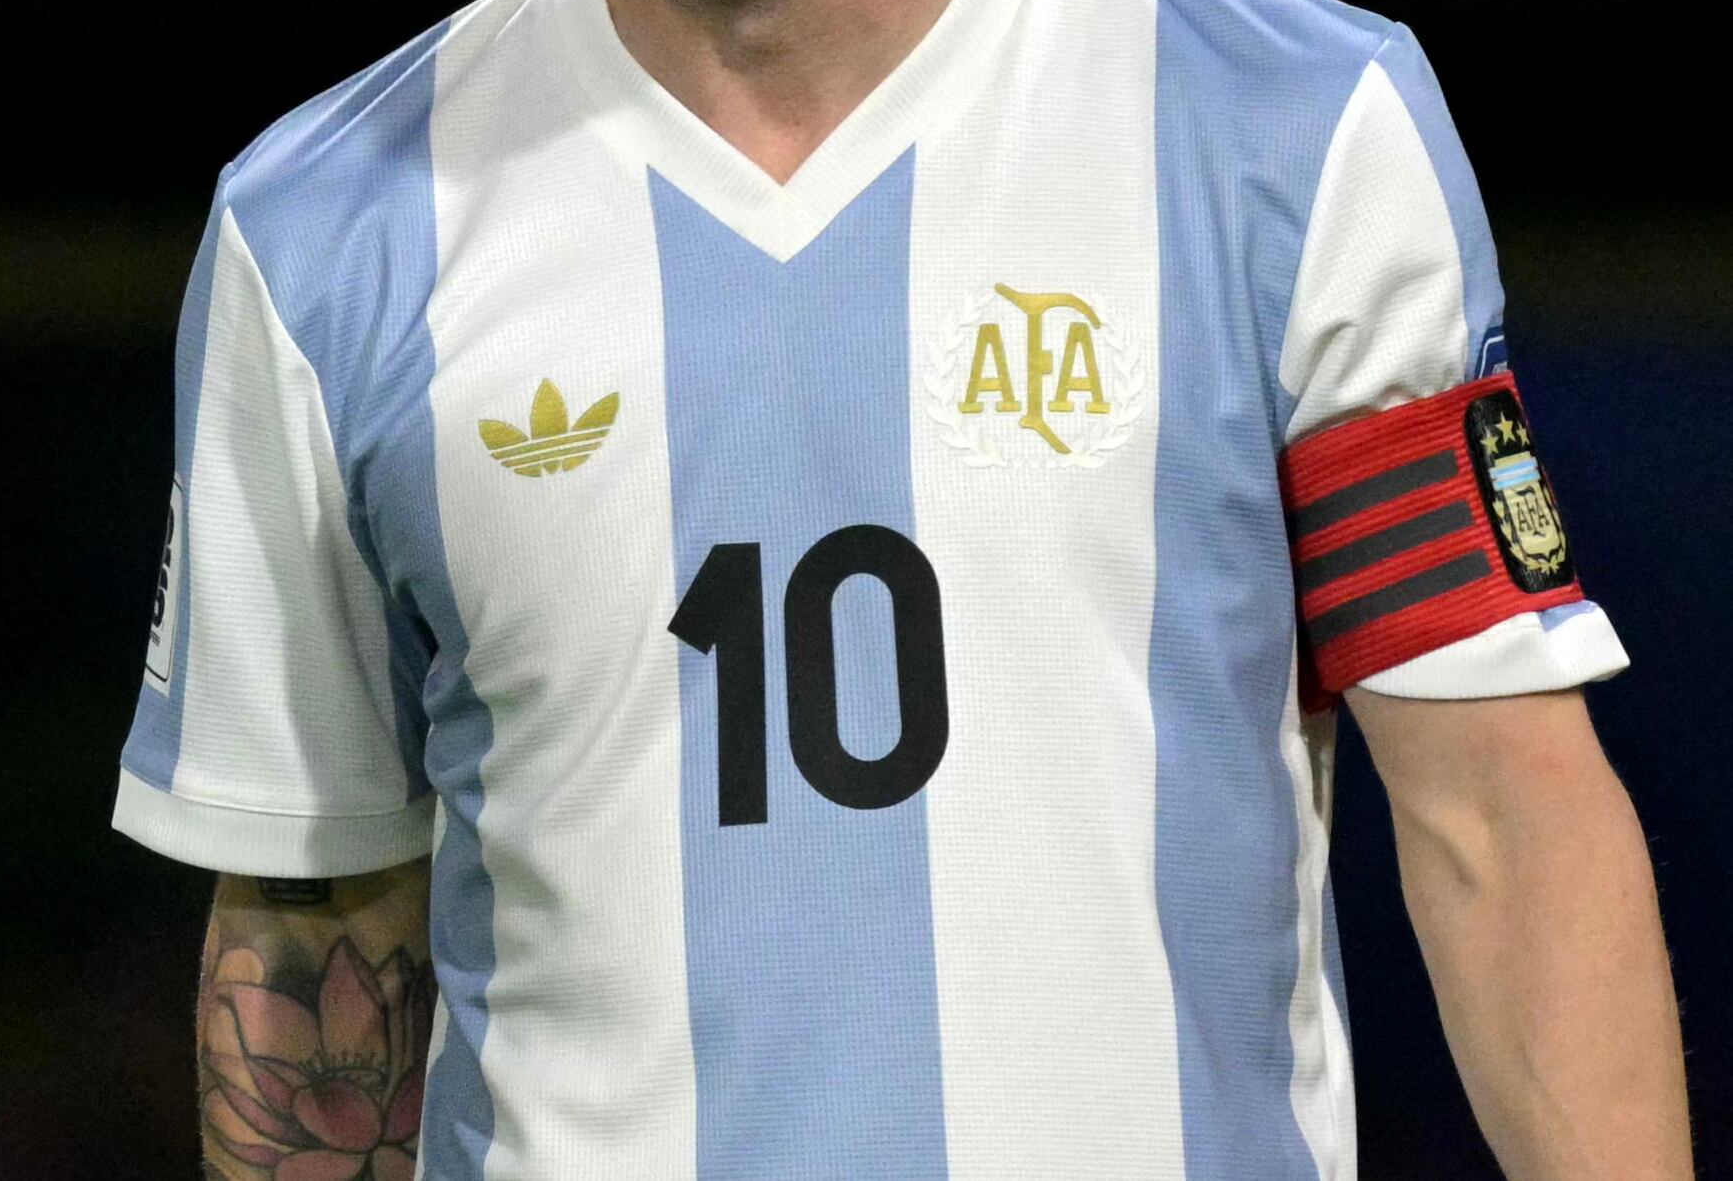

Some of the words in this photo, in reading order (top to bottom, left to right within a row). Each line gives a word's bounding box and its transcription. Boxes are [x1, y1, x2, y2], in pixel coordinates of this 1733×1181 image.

[958, 282, 1111, 455] AFA
[1516, 486, 1551, 538] AFA
[667, 524, 949, 826] 10
